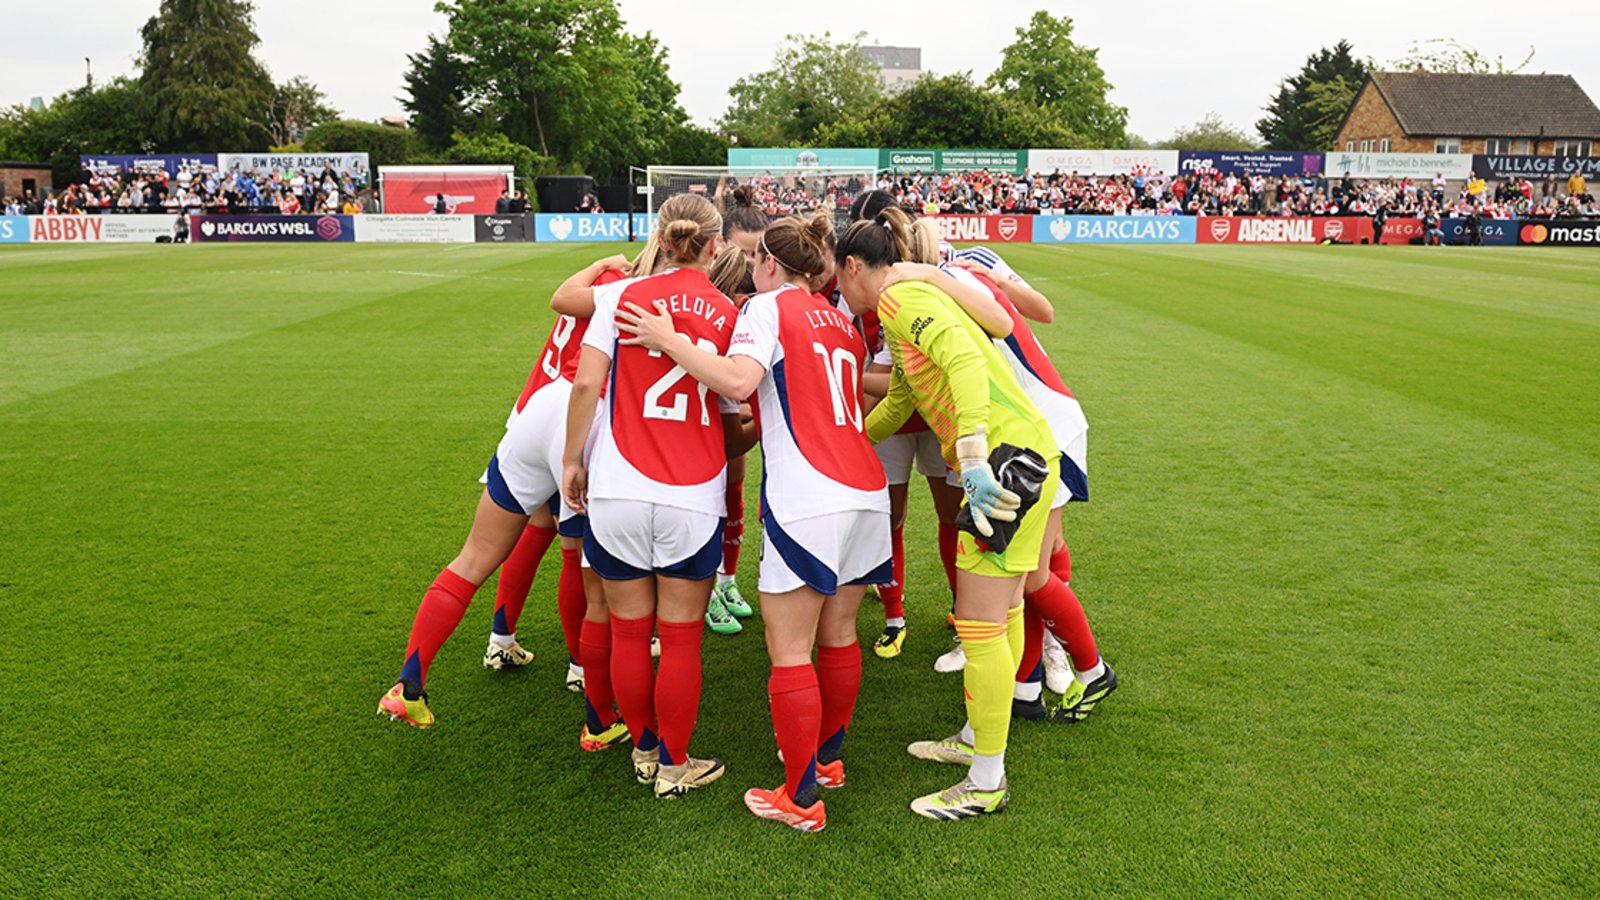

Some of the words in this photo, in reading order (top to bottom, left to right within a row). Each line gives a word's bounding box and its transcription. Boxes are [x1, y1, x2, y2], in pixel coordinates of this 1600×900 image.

[252, 157, 267, 167] BW
[271, 157, 293, 168] PASE
[297, 157, 342, 167] ACADEMY
[893, 155, 932, 164] Graham
[1046, 156, 1093, 165] OMEGA
[1113, 156, 1159, 165] OMEGA
[1376, 157, 1410, 168] michael
[1420, 158, 1453, 169] bennett
[1487, 158, 1556, 172] VILLAGE
[1562, 157, 1600, 172] GYM
[34, 217, 102, 241] ABBYY
[217, 223, 277, 235] BARCLAYS
[279, 223, 314, 235] WSL
[578, 217, 659, 237] BARCL
[936, 217, 989, 240] SENAL
[1076, 220, 1180, 239] BARCLAYS
[1238, 219, 1316, 242] ARSENAL
[1384, 225, 1423, 234] MEGA
[1453, 225, 1503, 236] OGA
[805, 309, 854, 339] LITTLE
[542, 314, 576, 380] 9
[812, 342, 863, 433] 10
